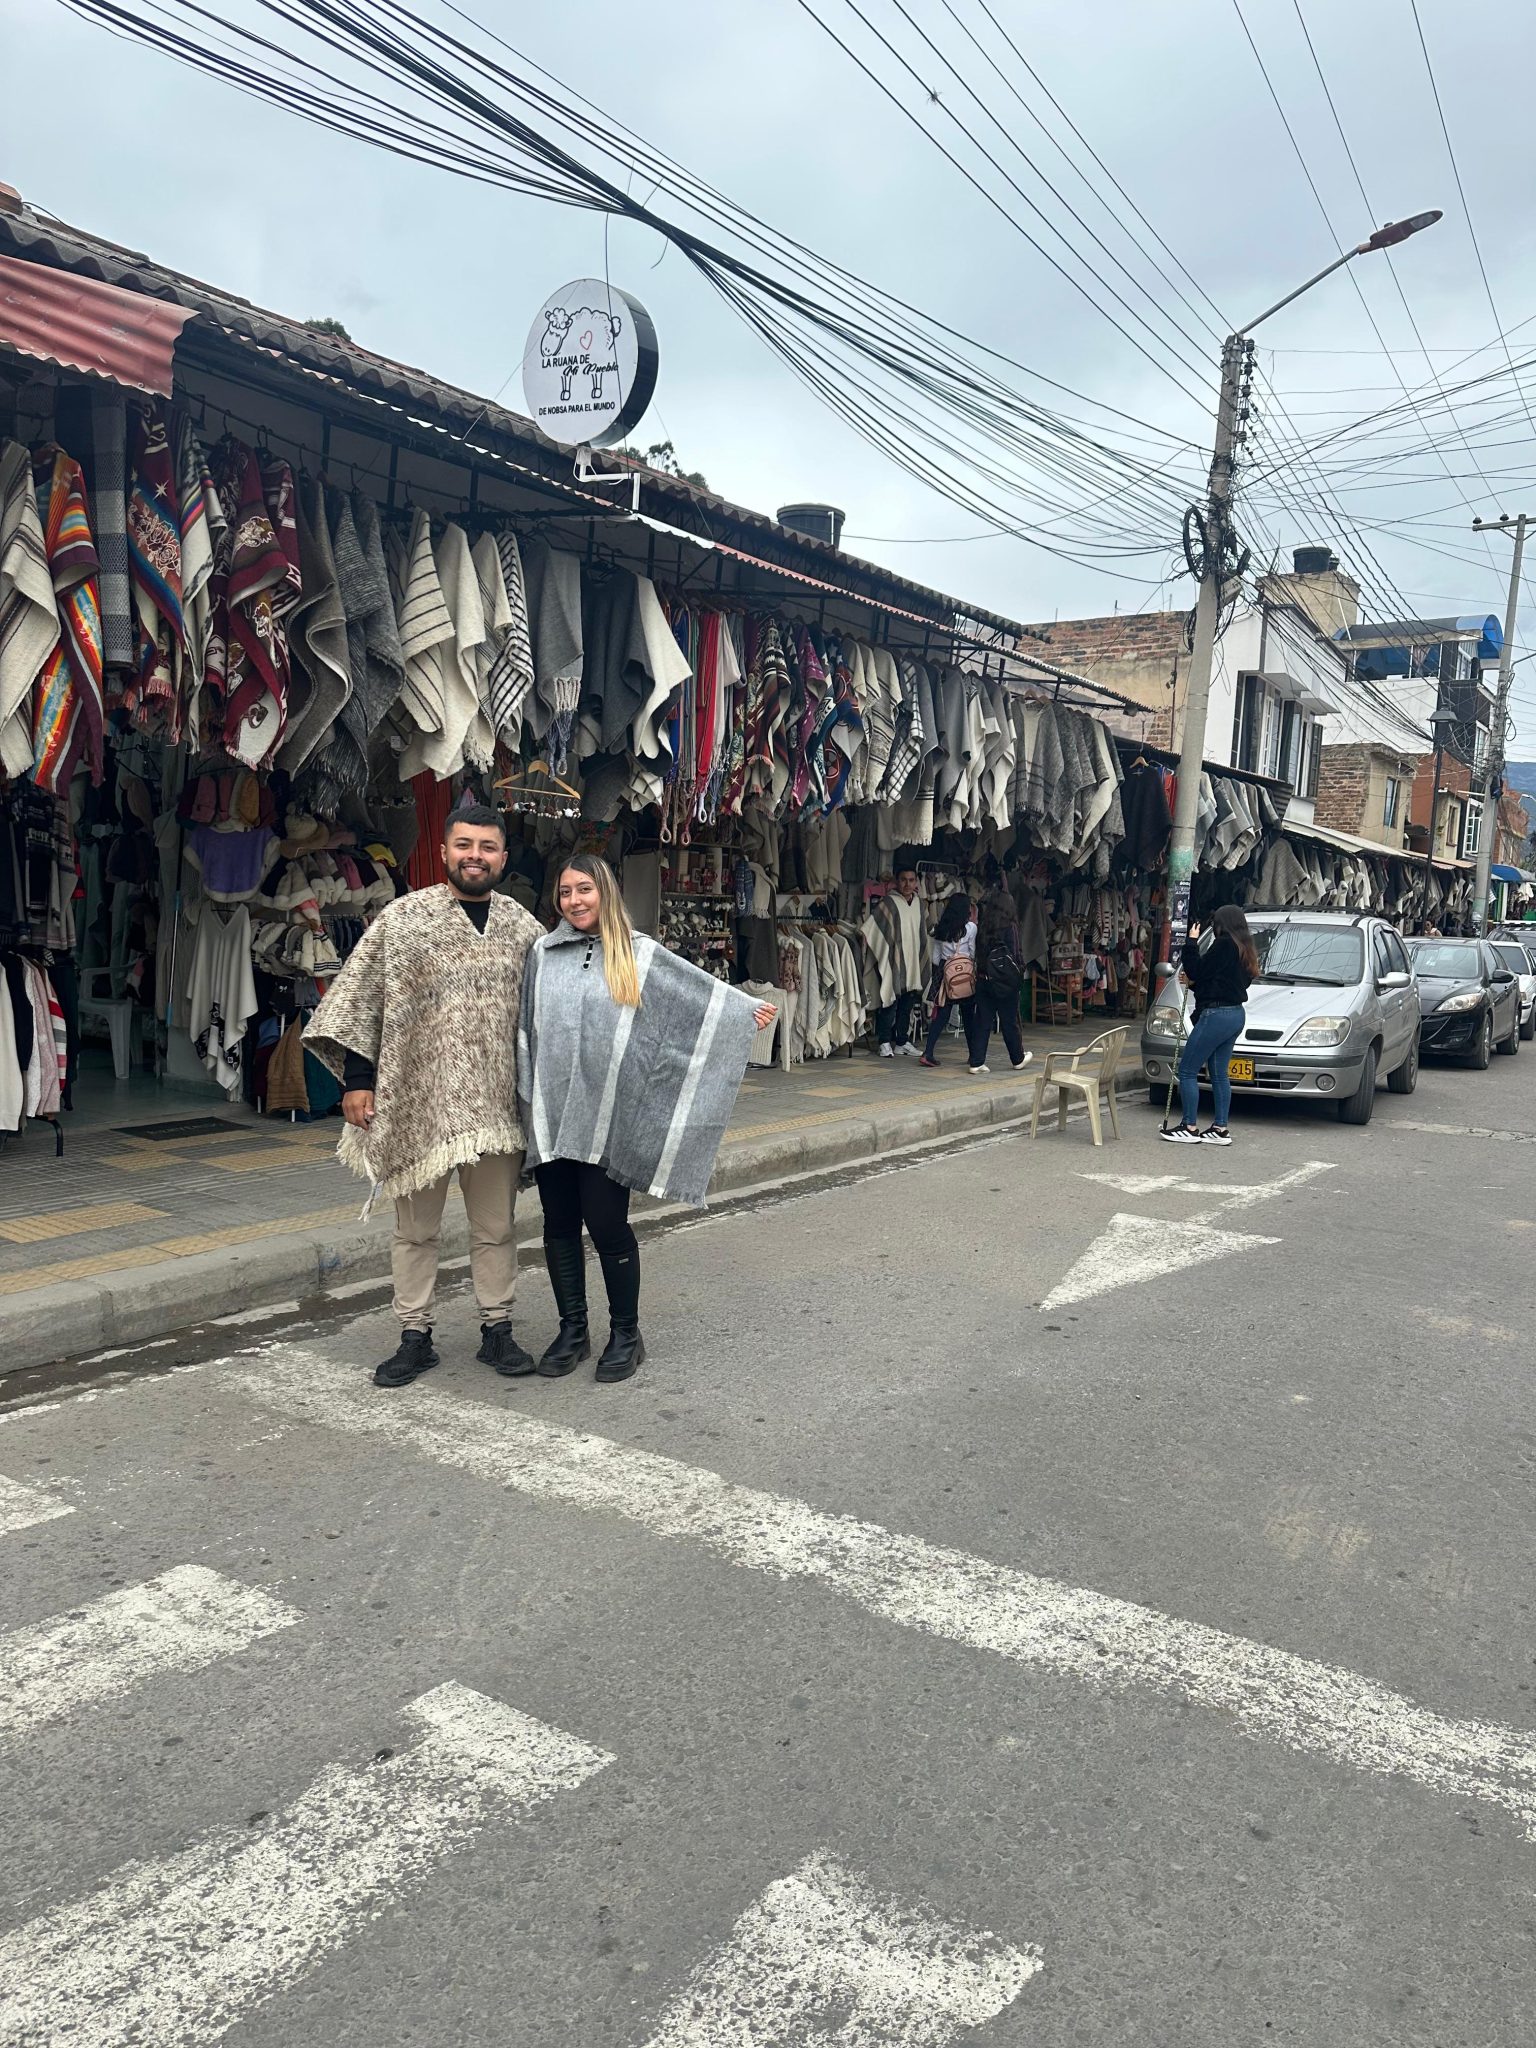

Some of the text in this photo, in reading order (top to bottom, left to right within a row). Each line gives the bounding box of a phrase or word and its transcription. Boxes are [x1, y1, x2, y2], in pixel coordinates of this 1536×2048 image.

[542, 354, 590, 368] LA RUANA DE
[563, 361, 618, 376] Mi Pueblo
[539, 402, 615, 415] DE NOBSA PARA EL MUNDO
[1231, 1063, 1251, 1075] 615
